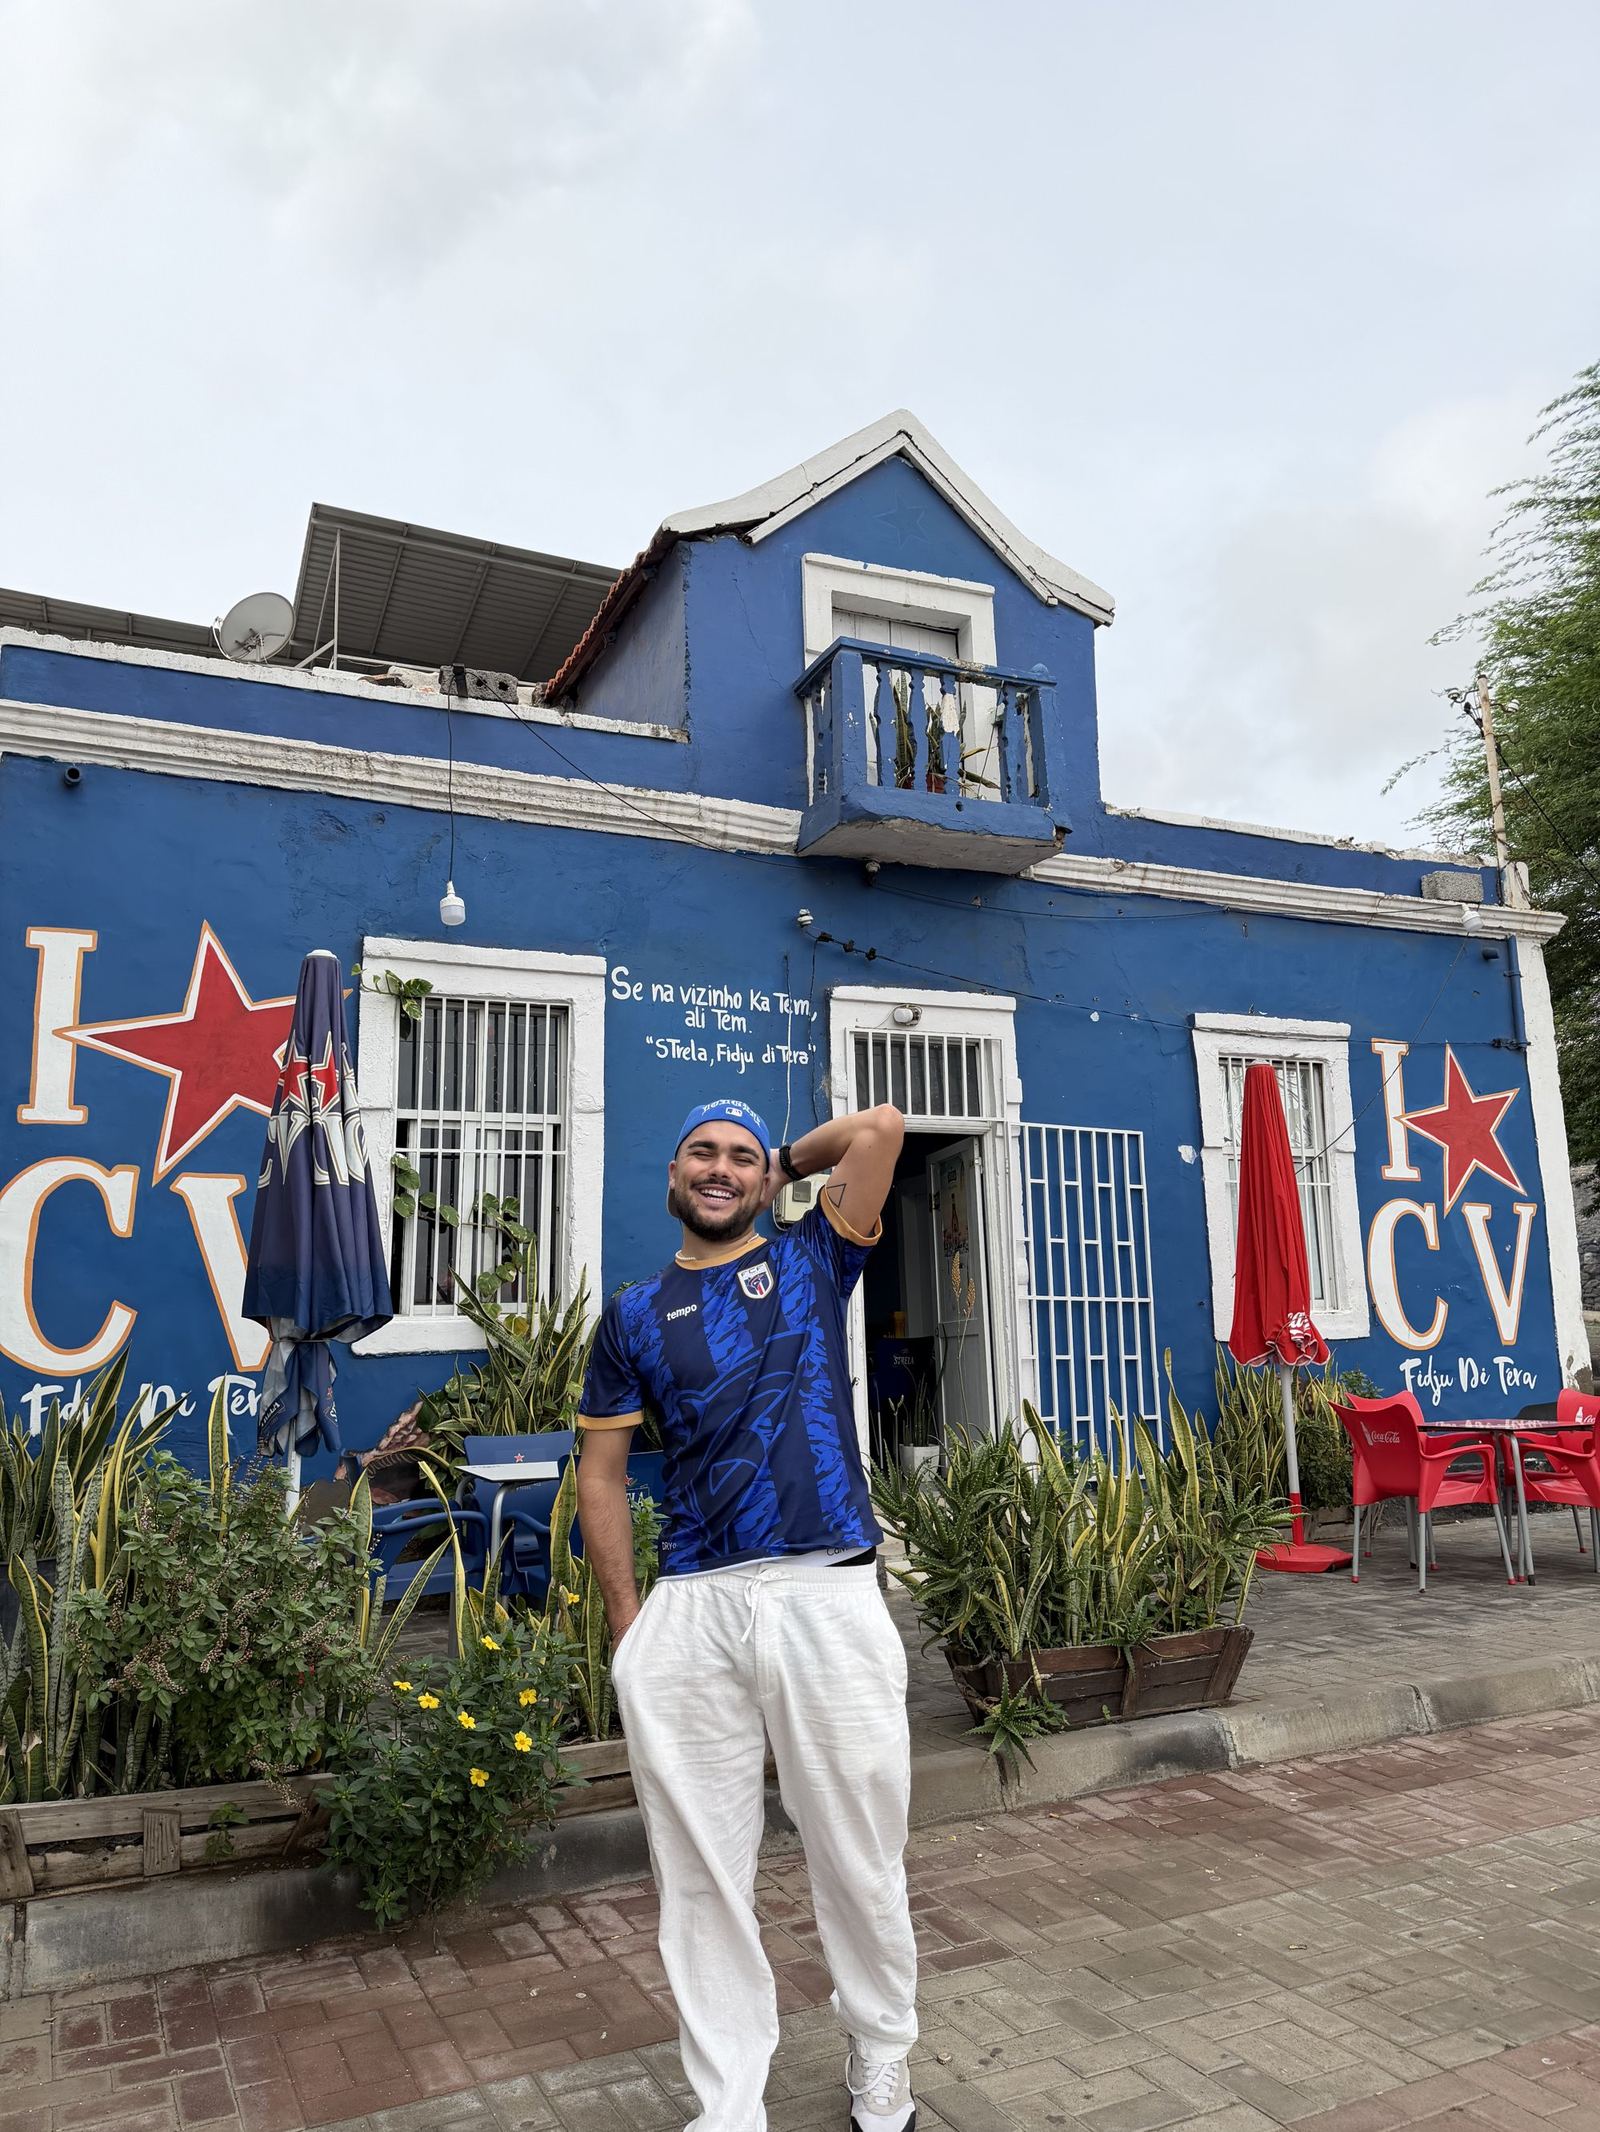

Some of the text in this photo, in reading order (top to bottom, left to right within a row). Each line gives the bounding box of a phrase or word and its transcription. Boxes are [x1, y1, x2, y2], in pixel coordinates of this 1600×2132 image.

[611, 966, 643, 1000] Se
[651, 983, 674, 1003] na
[679, 984, 742, 1009] vizinho
[685, 1006, 752, 1033] ali Tem.
[716, 1043, 753, 1074] Fidju
[762, 1044, 775, 1063] di
[666, 1304, 697, 1321] tempo
[1399, 1355, 1453, 1406] Fidju
[1458, 1357, 1490, 1392] Di
[139, 1383, 196, 1430] Di
[207, 1375, 262, 1436] Tér
